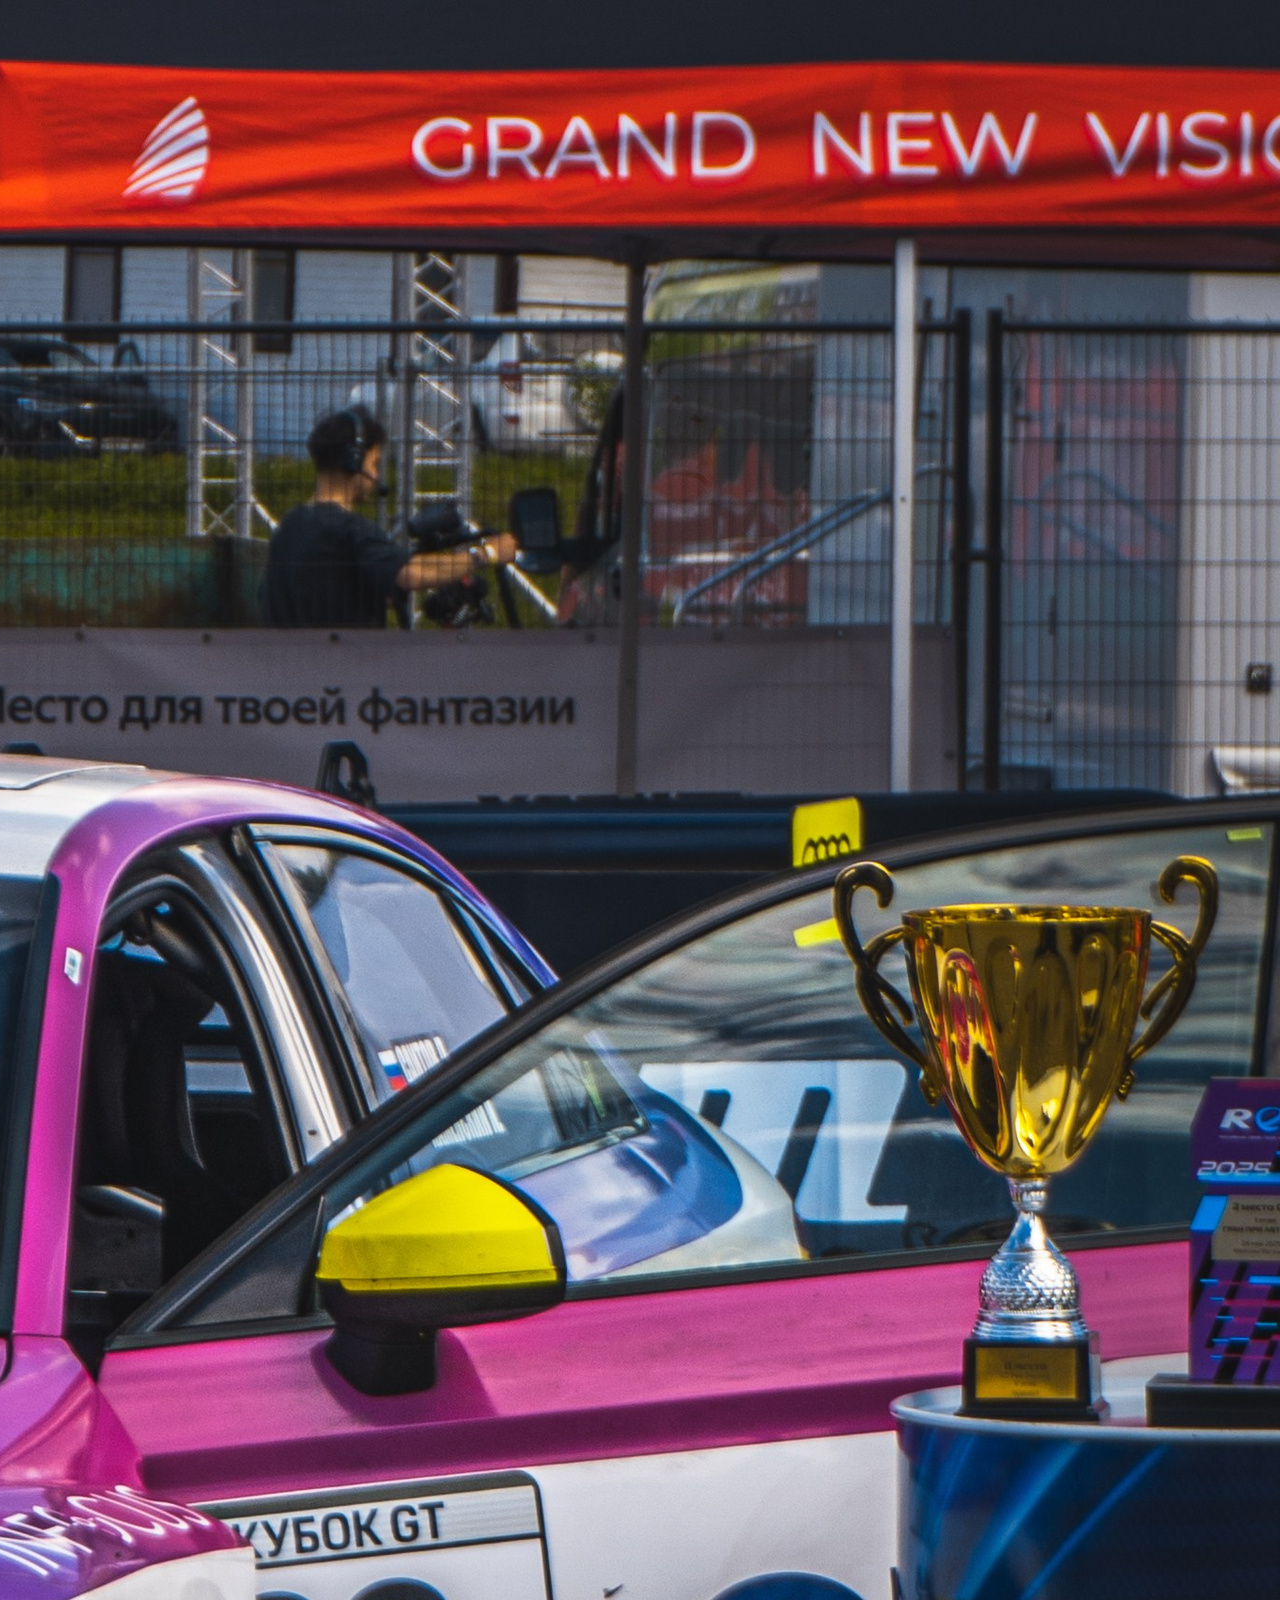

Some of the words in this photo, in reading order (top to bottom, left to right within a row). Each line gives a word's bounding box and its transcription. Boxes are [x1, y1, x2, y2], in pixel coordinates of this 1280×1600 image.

[411, 111, 756, 179] GRAND
[812, 111, 1037, 177] NEW
[120, 695, 203, 731] для
[217, 686, 346, 725] твоей
[357, 687, 575, 732] фантазии
[1197, 1160, 1272, 1176] 2025
[231, 1507, 383, 1559] КУБОК
[389, 1500, 445, 1541] GT
